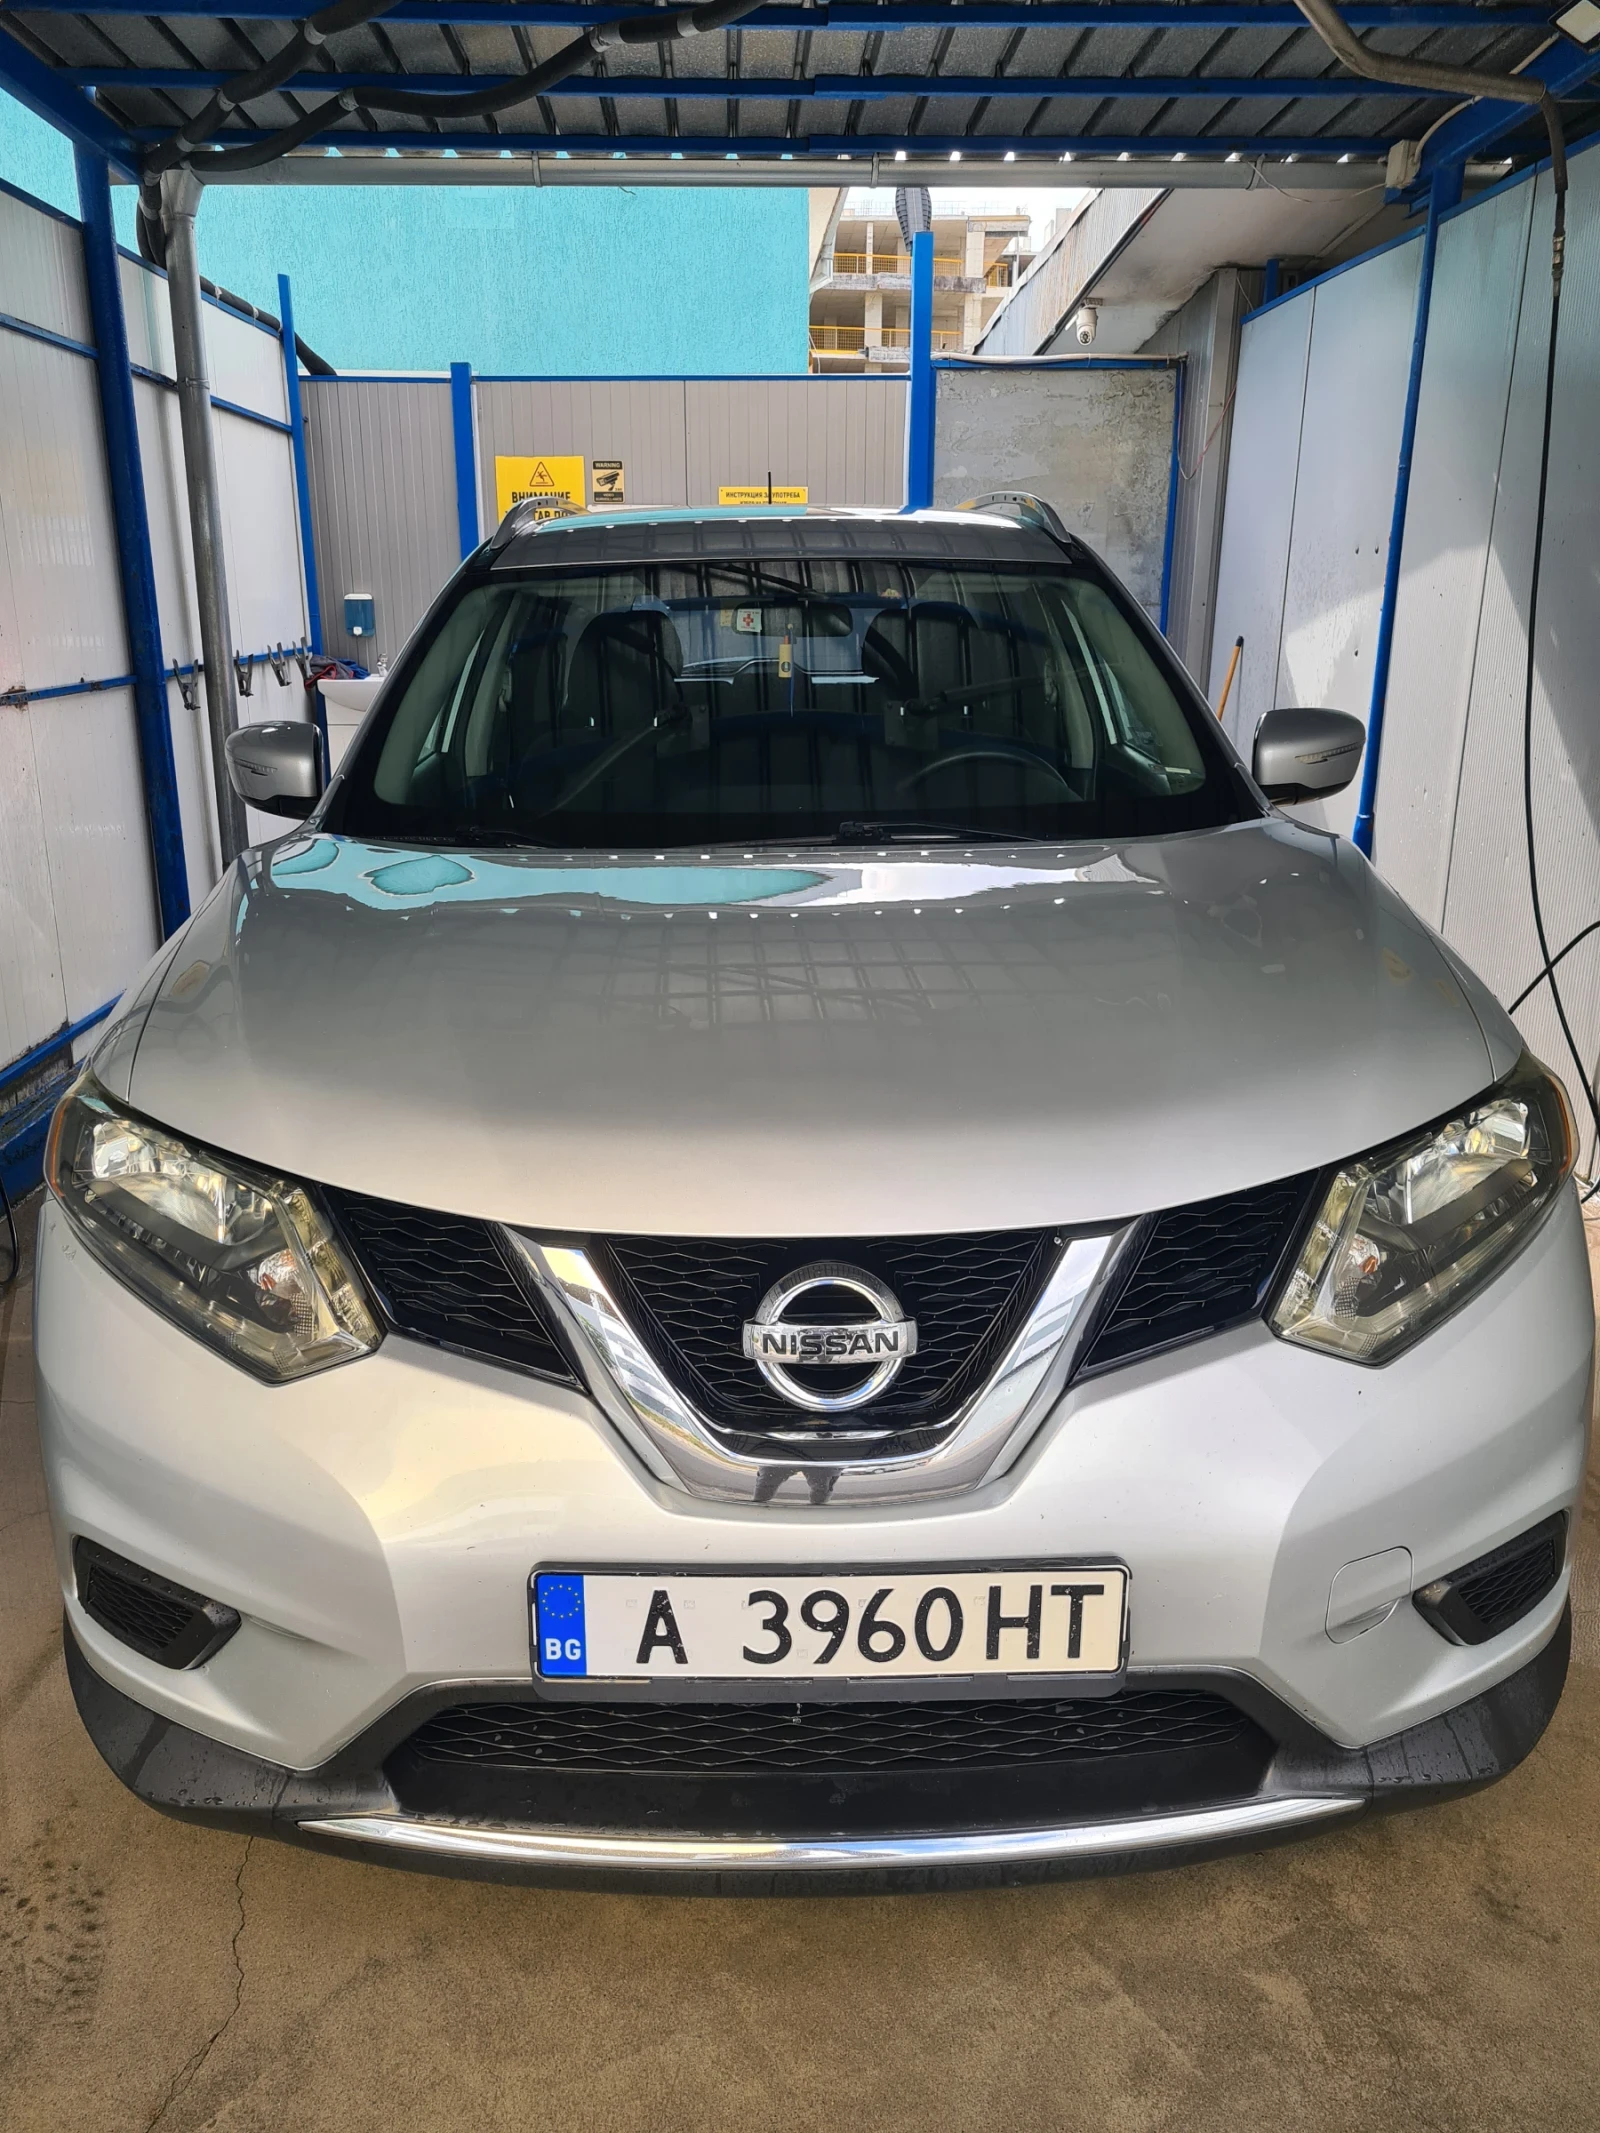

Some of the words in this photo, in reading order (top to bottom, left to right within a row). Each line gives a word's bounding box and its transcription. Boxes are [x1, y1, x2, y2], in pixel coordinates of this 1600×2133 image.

[762, 1331, 899, 1355] NISSAN
[636, 1589, 689, 1664] A
[545, 1638, 582, 1661] BG
